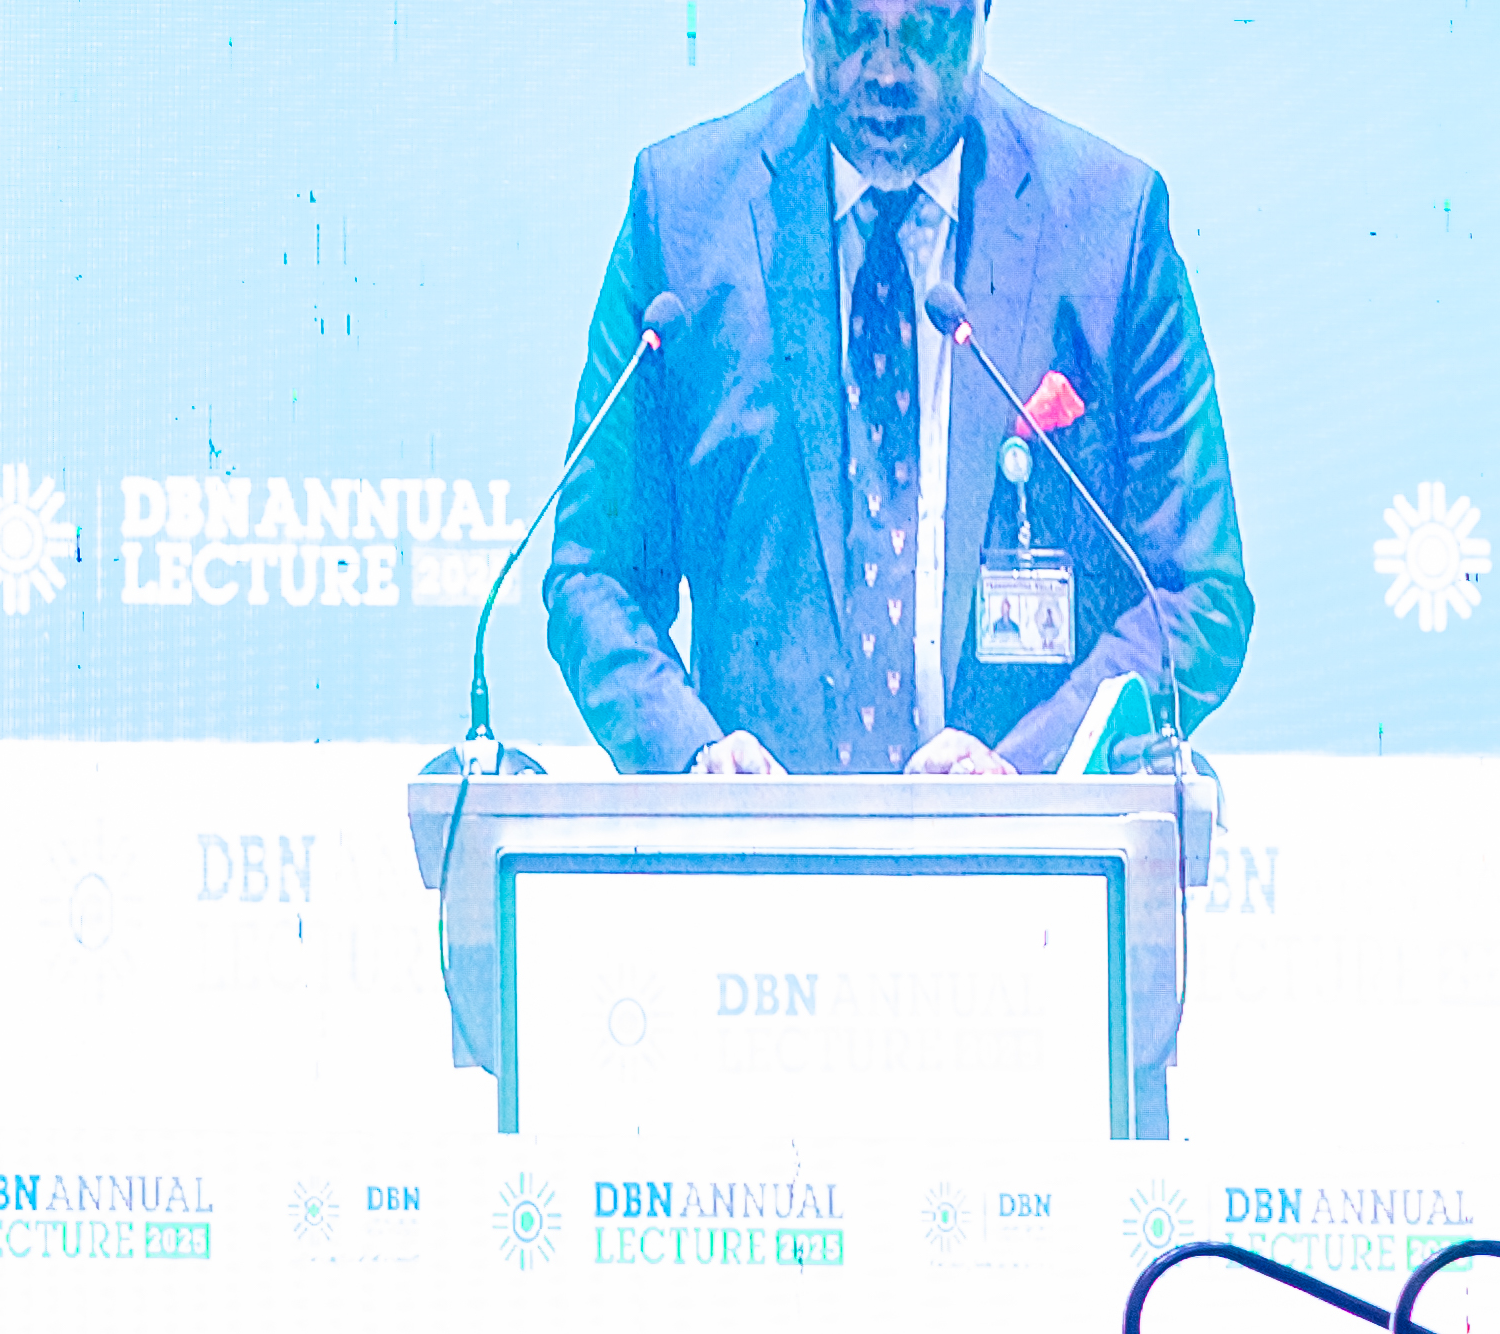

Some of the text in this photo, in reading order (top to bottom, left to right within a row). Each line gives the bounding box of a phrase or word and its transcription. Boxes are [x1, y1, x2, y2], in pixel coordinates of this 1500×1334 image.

[121, 476, 525, 540] DBN ANNUAL
[121, 544, 400, 605] LECTURE
[197, 834, 316, 902] DBN
[1205, 847, 1280, 915] BN
[717, 973, 819, 1017] DBN
[46, 1175, 213, 1212] ANNUAL
[367, 1186, 420, 1211] DBN
[594, 1181, 843, 1218] DBN ANNUAL
[999, 1193, 1051, 1217] DBN
[1225, 1187, 1473, 1225] DBN ANNUAL
[595, 1227, 765, 1264] LECTURE
